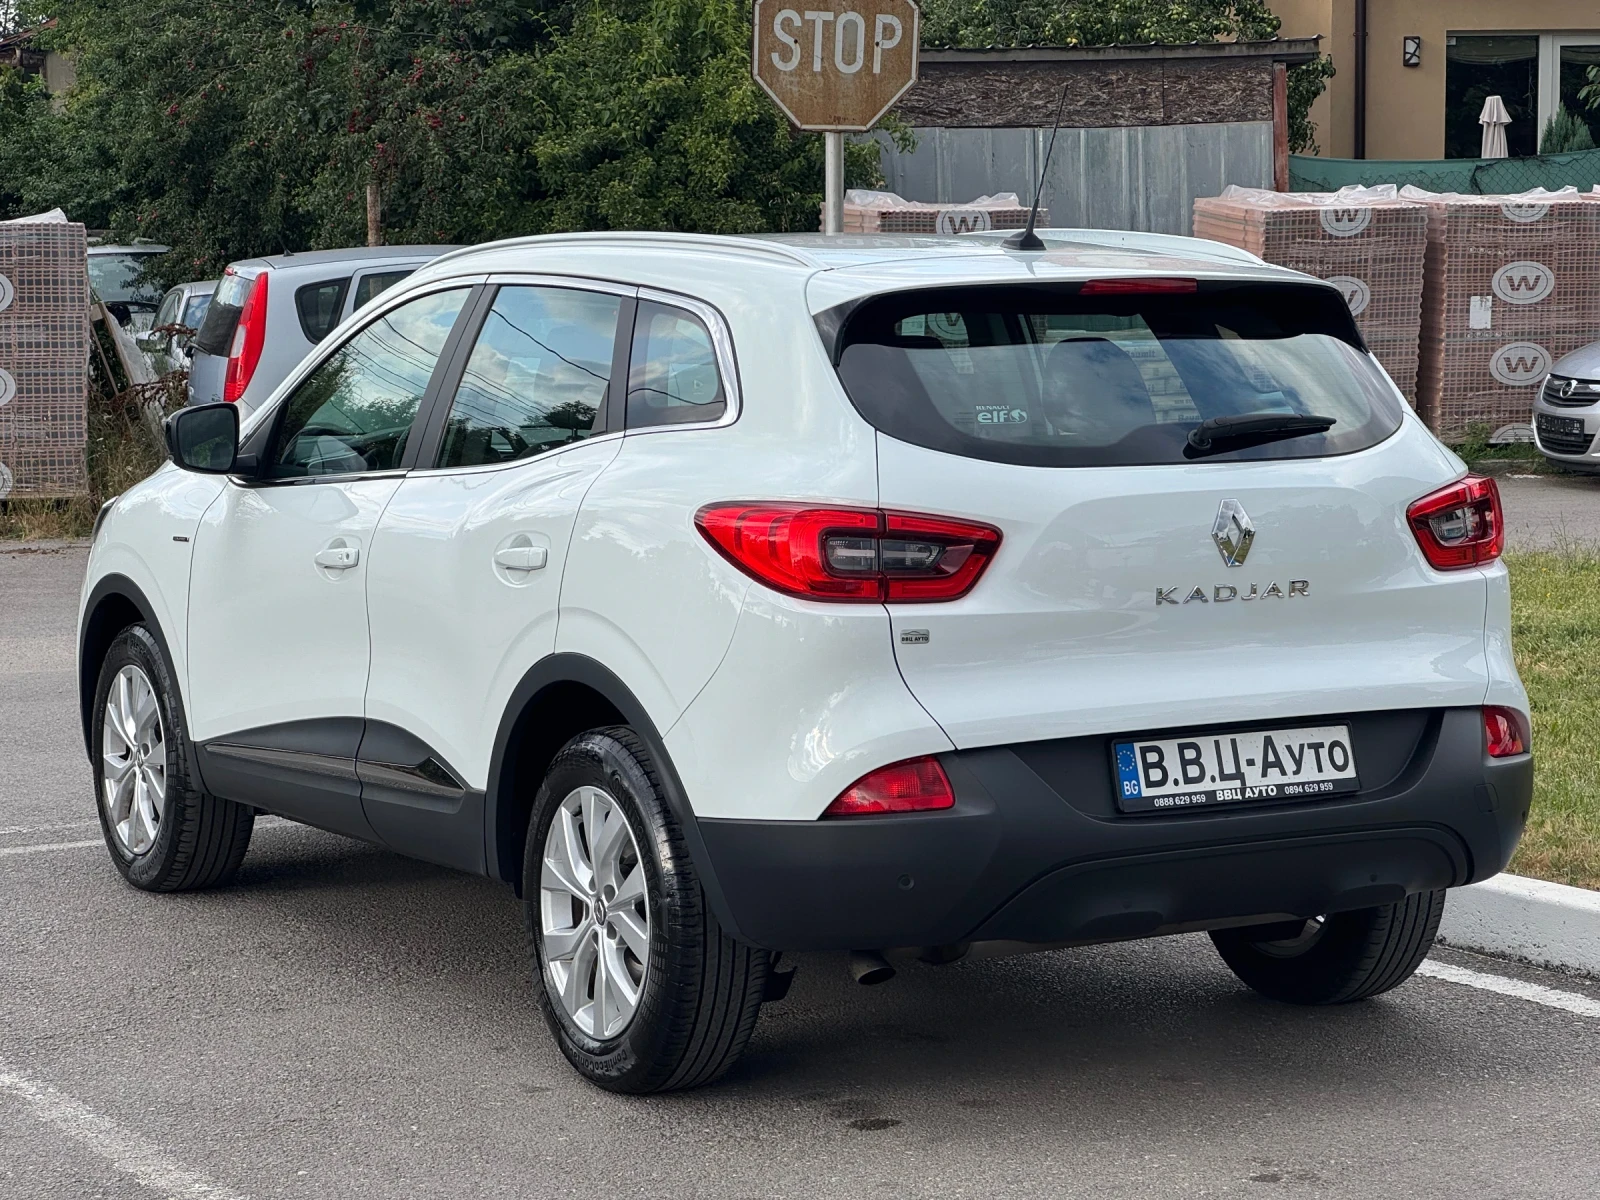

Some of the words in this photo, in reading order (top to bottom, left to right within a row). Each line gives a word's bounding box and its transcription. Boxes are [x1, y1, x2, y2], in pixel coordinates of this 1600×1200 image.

[771, 9, 903, 74] STOP
[947, 216, 979, 234] W
[1505, 274, 1542, 292] W
[1503, 356, 1539, 373] W
[977, 410, 1008, 423] elf
[1155, 579, 1310, 606] KADJAR
[1123, 779, 1139, 796] BG
[1154, 796, 1174, 807] 0888
[1174, 795, 1190, 806] 629
[1190, 794, 1206, 804] 959
[1216, 787, 1243, 801] ВВЦ
[1244, 785, 1277, 799] АУТО
[1284, 784, 1303, 795] 0894
[1304, 783, 1319, 793] 629
[1319, 782, 1334, 792] 959
